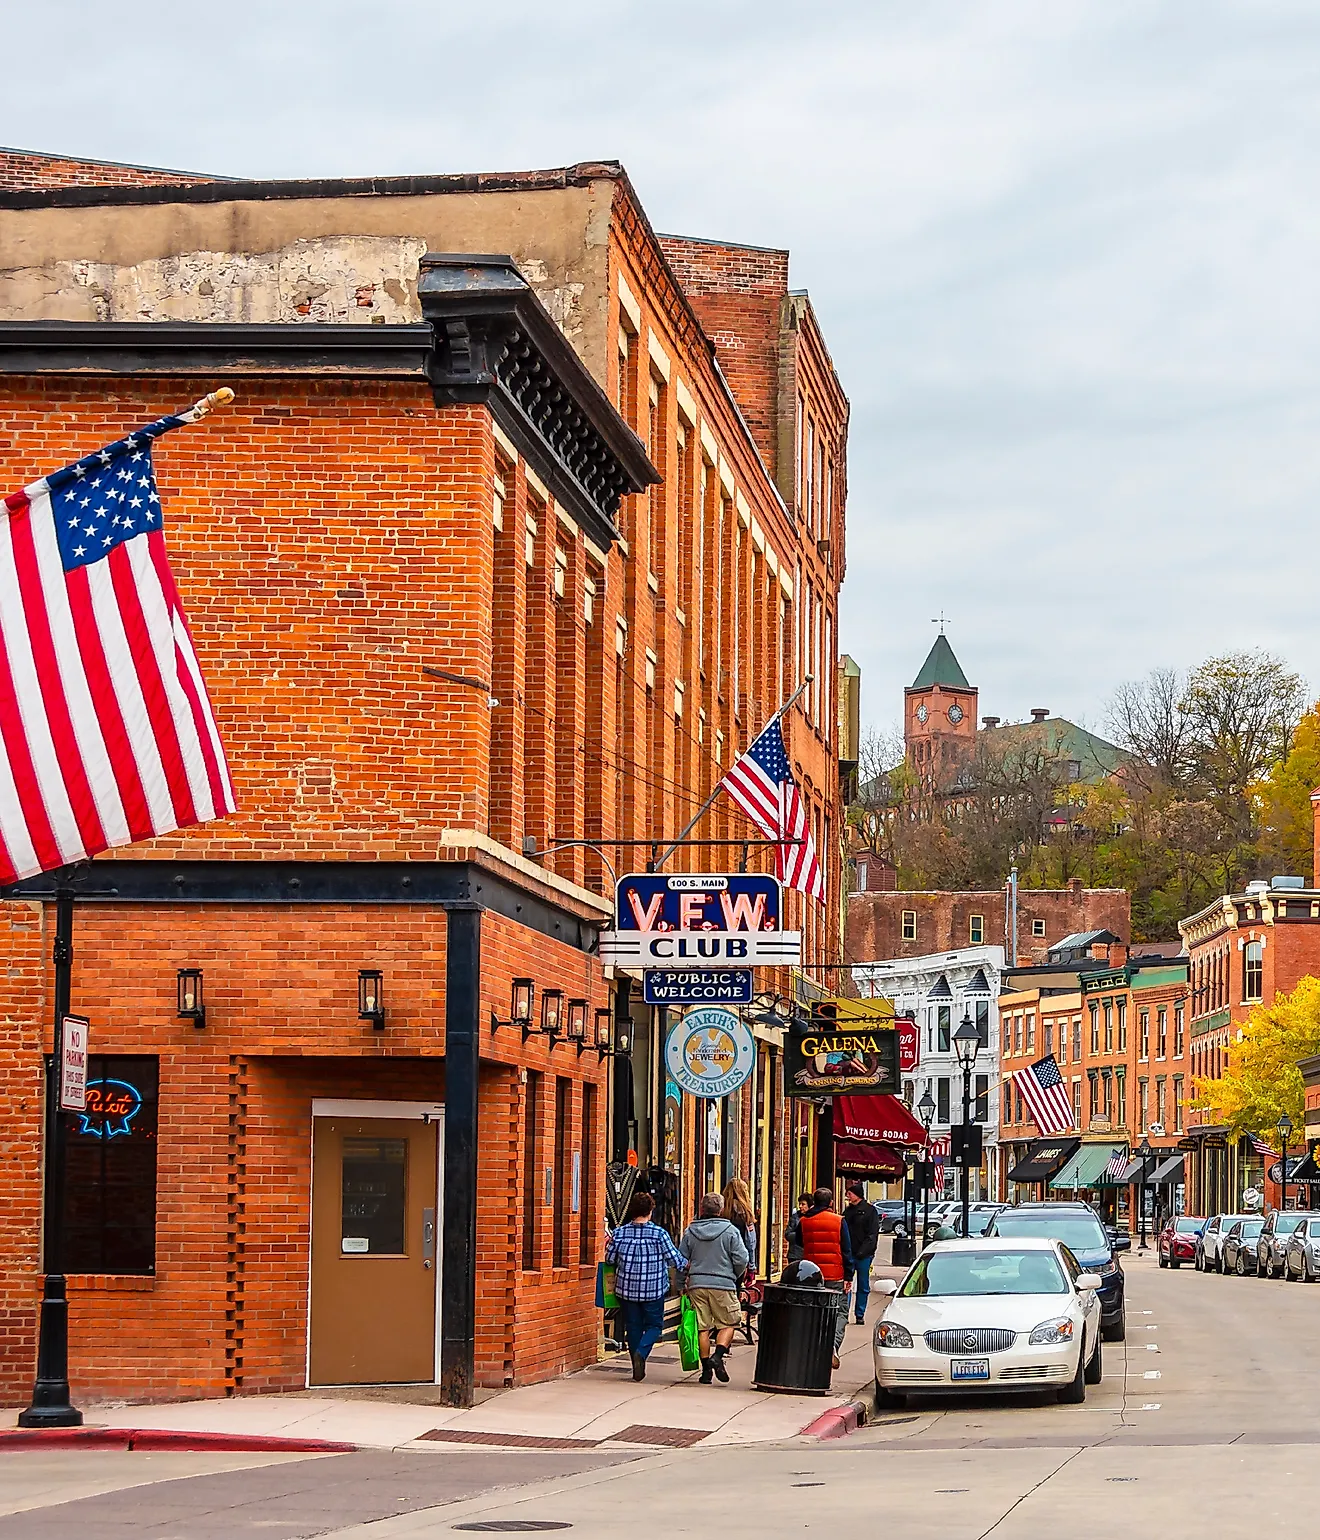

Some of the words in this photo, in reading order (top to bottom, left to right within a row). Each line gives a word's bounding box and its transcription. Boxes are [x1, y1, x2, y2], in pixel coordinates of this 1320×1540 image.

[702, 879, 725, 887] MAIN
[649, 938, 748, 958] CLUB
[666, 973, 731, 984] PUBLIC
[653, 986, 743, 998] WELCOME
[685, 1013, 738, 1031] EARTH'S
[71, 1031, 80, 1048] NO
[801, 1036, 881, 1057] GALENA
[66, 1049, 84, 1068] PARKING
[66, 1070, 75, 1083] THIS
[75, 1072, 84, 1085] SIDE
[676, 1066, 744, 1093] TREASURES
[808, 1077, 842, 1086] CANNING
[845, 1077, 878, 1085] COMPANY
[71, 1087, 84, 1099] STREET
[845, 1126, 879, 1137] VINTAGE
[882, 1130, 909, 1140] SODAS
